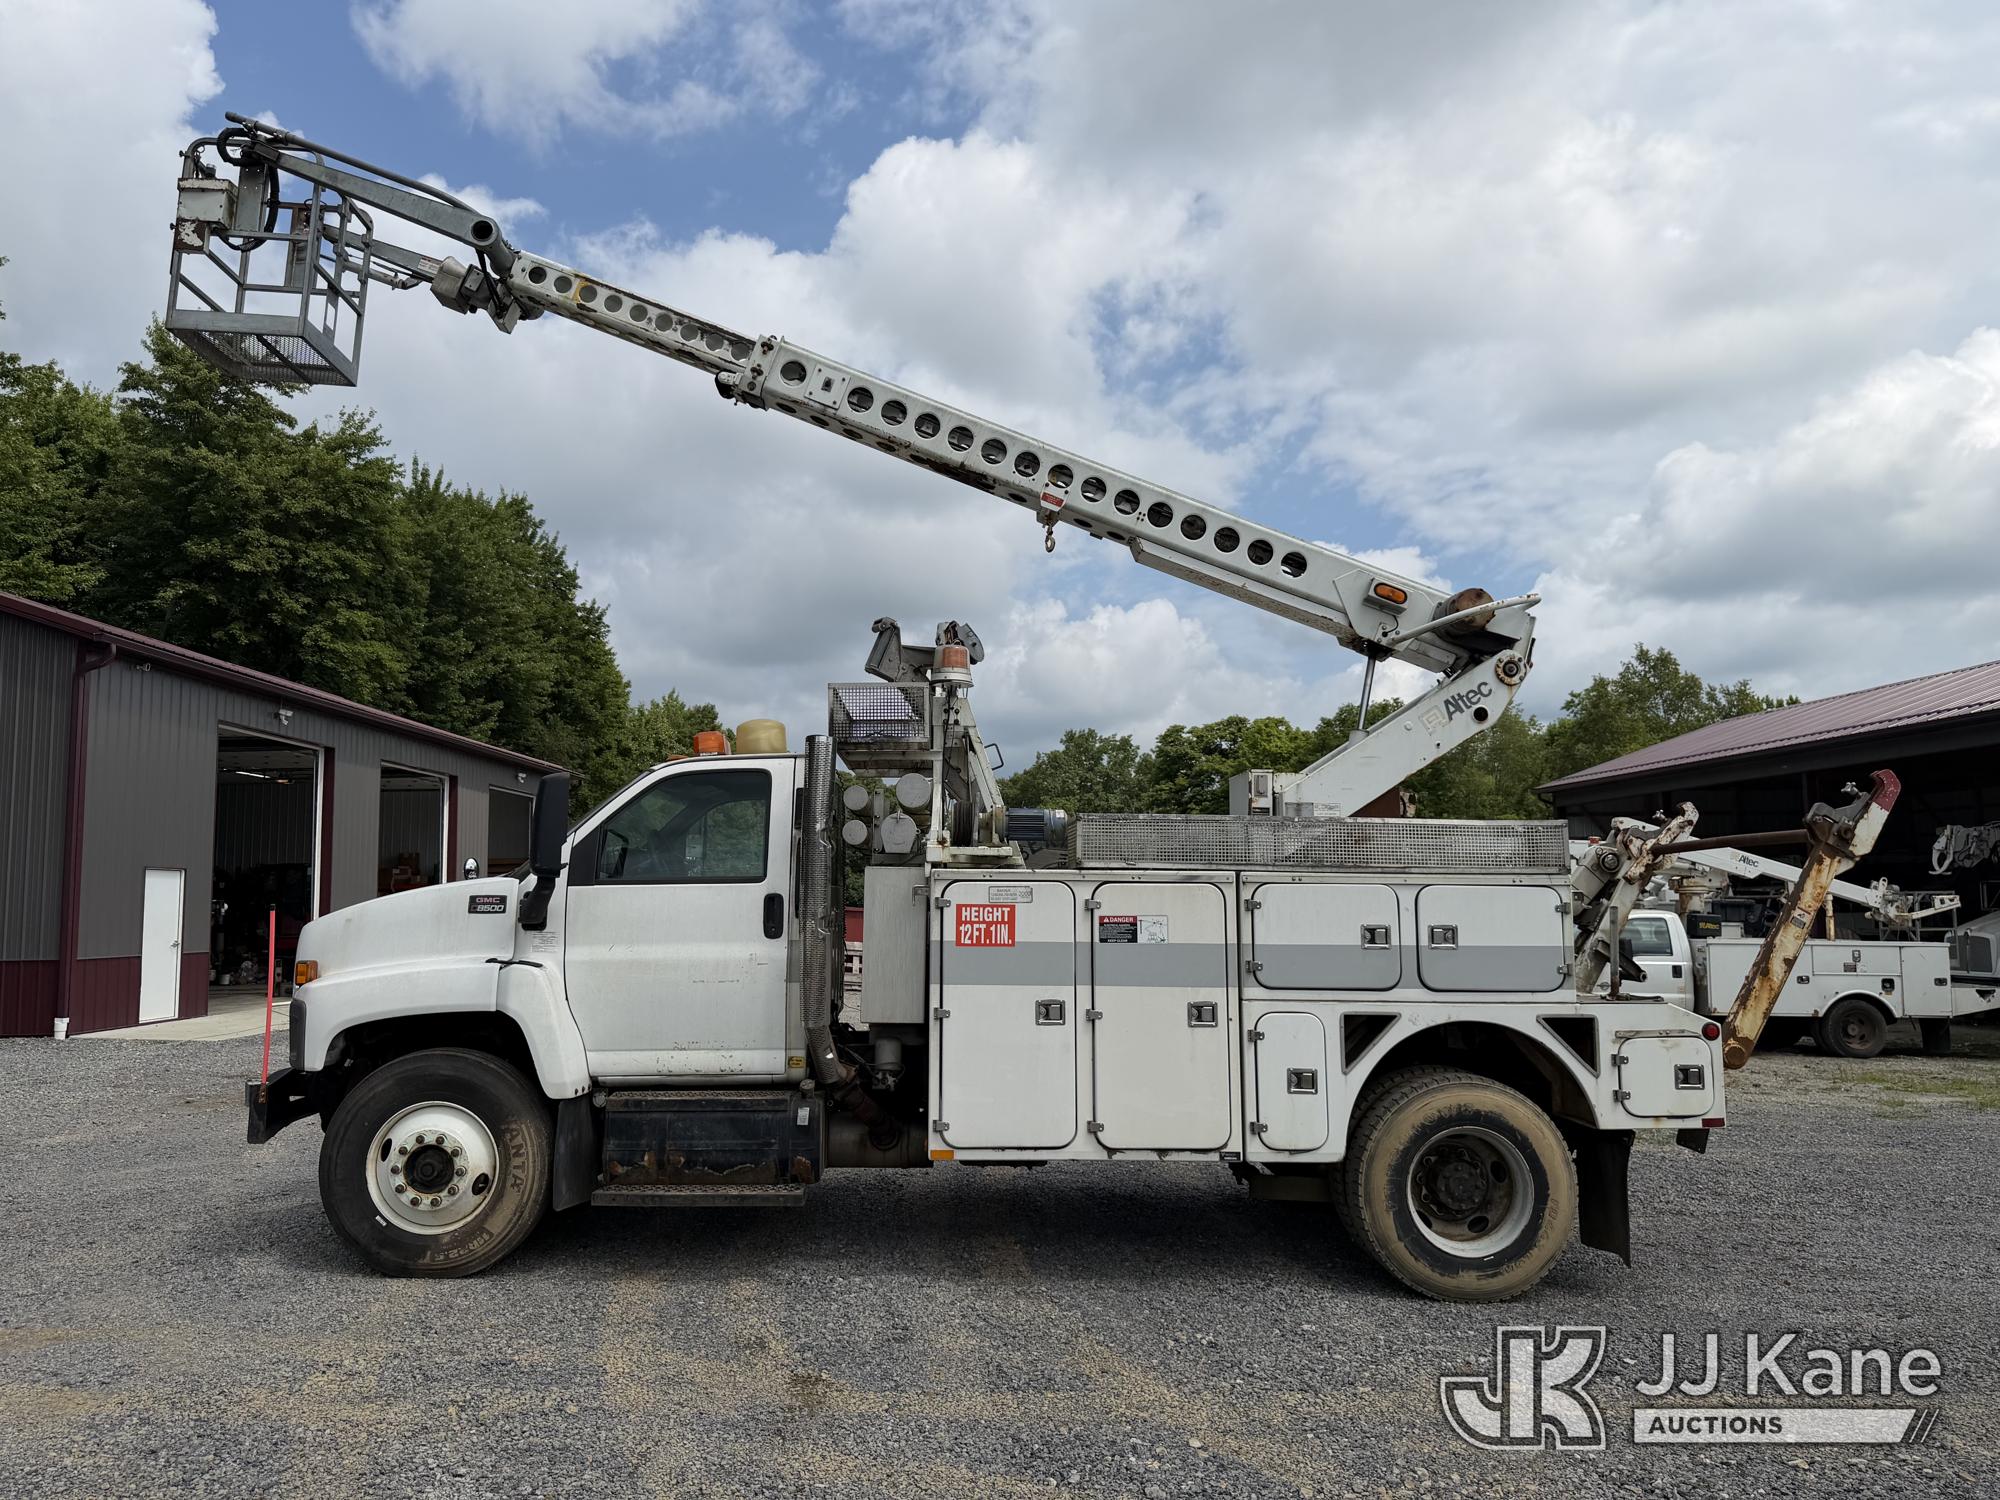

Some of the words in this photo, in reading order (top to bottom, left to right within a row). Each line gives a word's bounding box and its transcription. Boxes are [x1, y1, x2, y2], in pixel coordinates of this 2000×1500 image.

[1443, 681, 1493, 722] Altec
[1738, 854, 1759, 868] Altec
[961, 906, 1011, 922] HEIGHT
